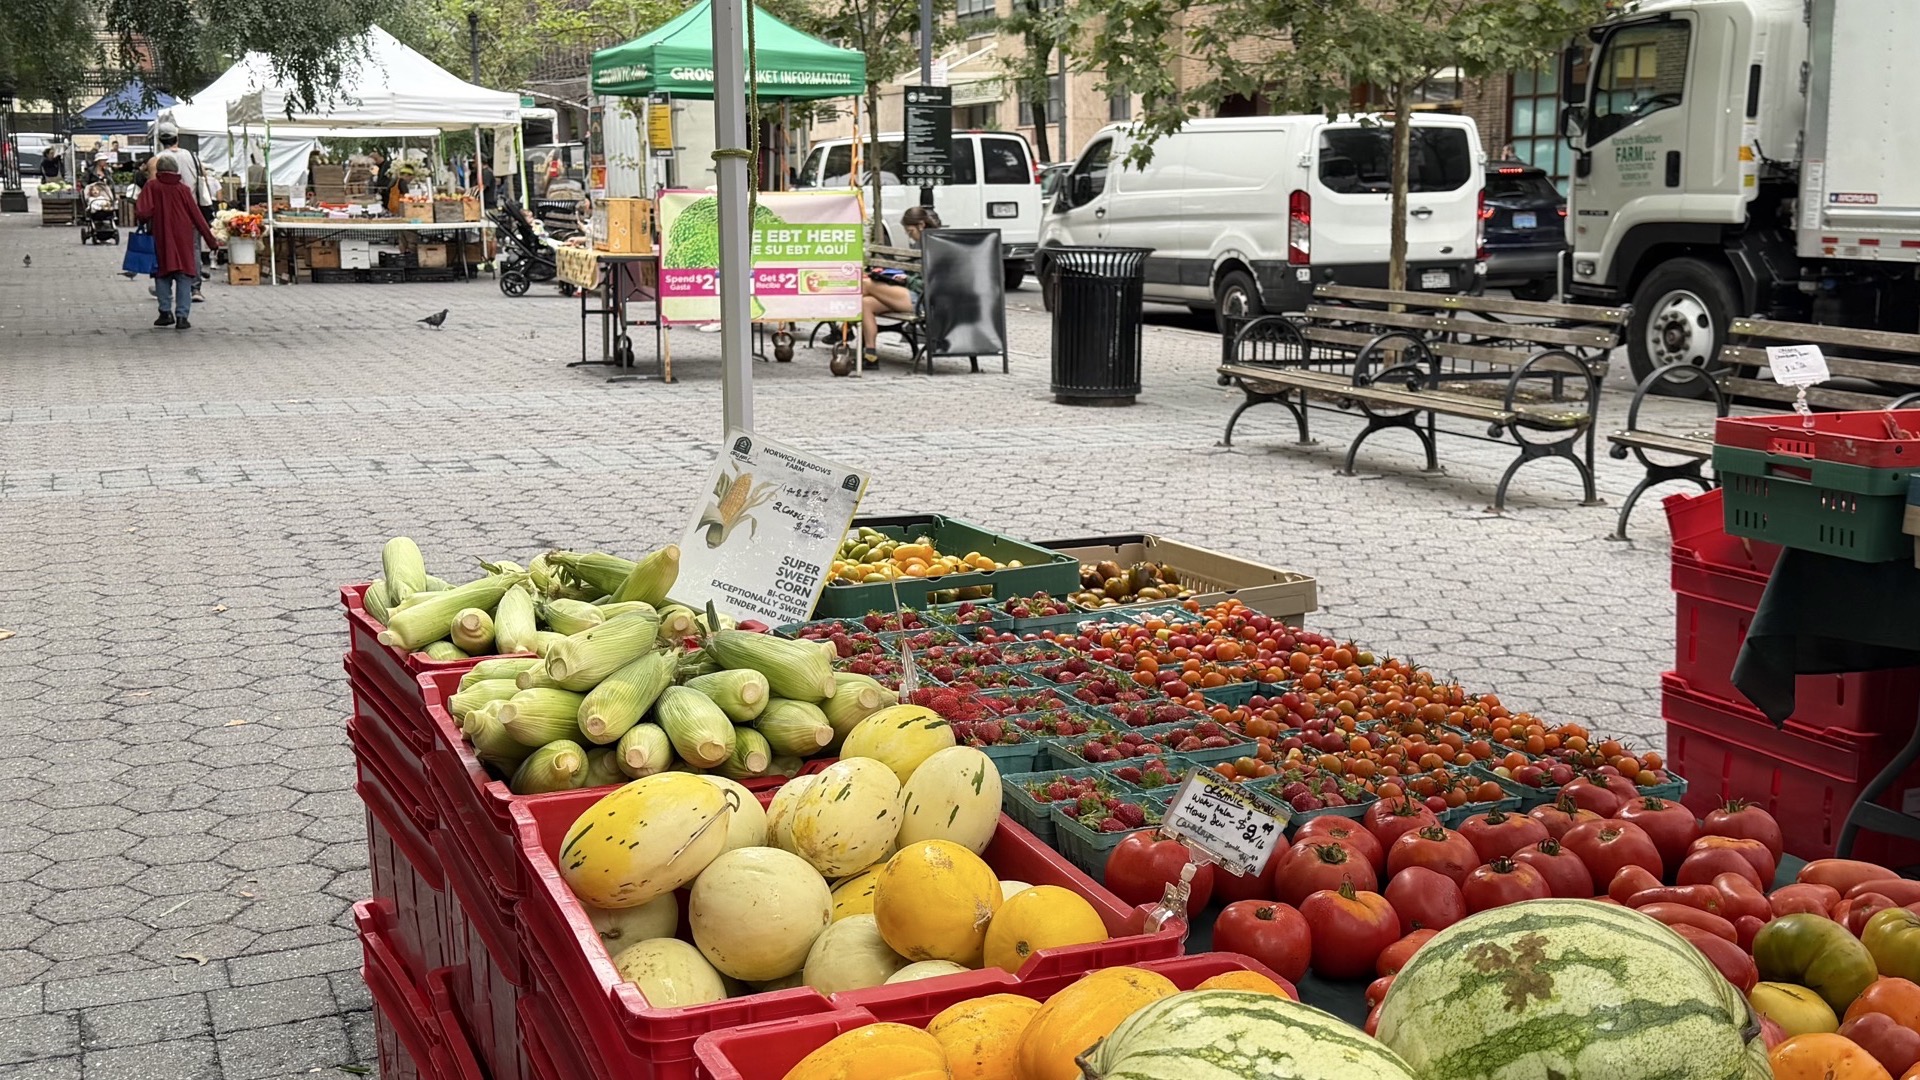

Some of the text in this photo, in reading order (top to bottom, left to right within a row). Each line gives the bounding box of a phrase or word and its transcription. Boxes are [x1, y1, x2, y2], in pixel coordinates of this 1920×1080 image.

[780, 71, 851, 85] INFORMATION
[1616, 146, 1656, 162] FARM LLC
[767, 230, 802, 242] EBT
[807, 230, 856, 243] HERE
[765, 245, 782, 254] SU
[786, 245, 811, 255] EBT
[815, 243, 848, 256] AQUÍ
[665, 274, 714, 290] Spend $2
[669, 283, 691, 291] Gasta
[759, 274, 797, 289] Get $2
[763, 447, 832, 475] NORWICH MEADOWS
[785, 461, 805, 473] FARM
[773, 501, 782, 512] 2
[781, 555, 820, 576] SUPER
[776, 566, 818, 587] SWEET
[775, 579, 812, 598] CORN
[711, 579, 807, 618] EXCEPTIONALLY SWEET
[726, 595, 757, 612] TENDER
[757, 607, 777, 618] AND
[767, 589, 808, 608] BI-COLOR
[1192, 793, 1214, 808] Water
[1203, 784, 1244, 808] ORGANIC
[1184, 803, 1207, 822] Honey
[1210, 813, 1225, 828] Dew
